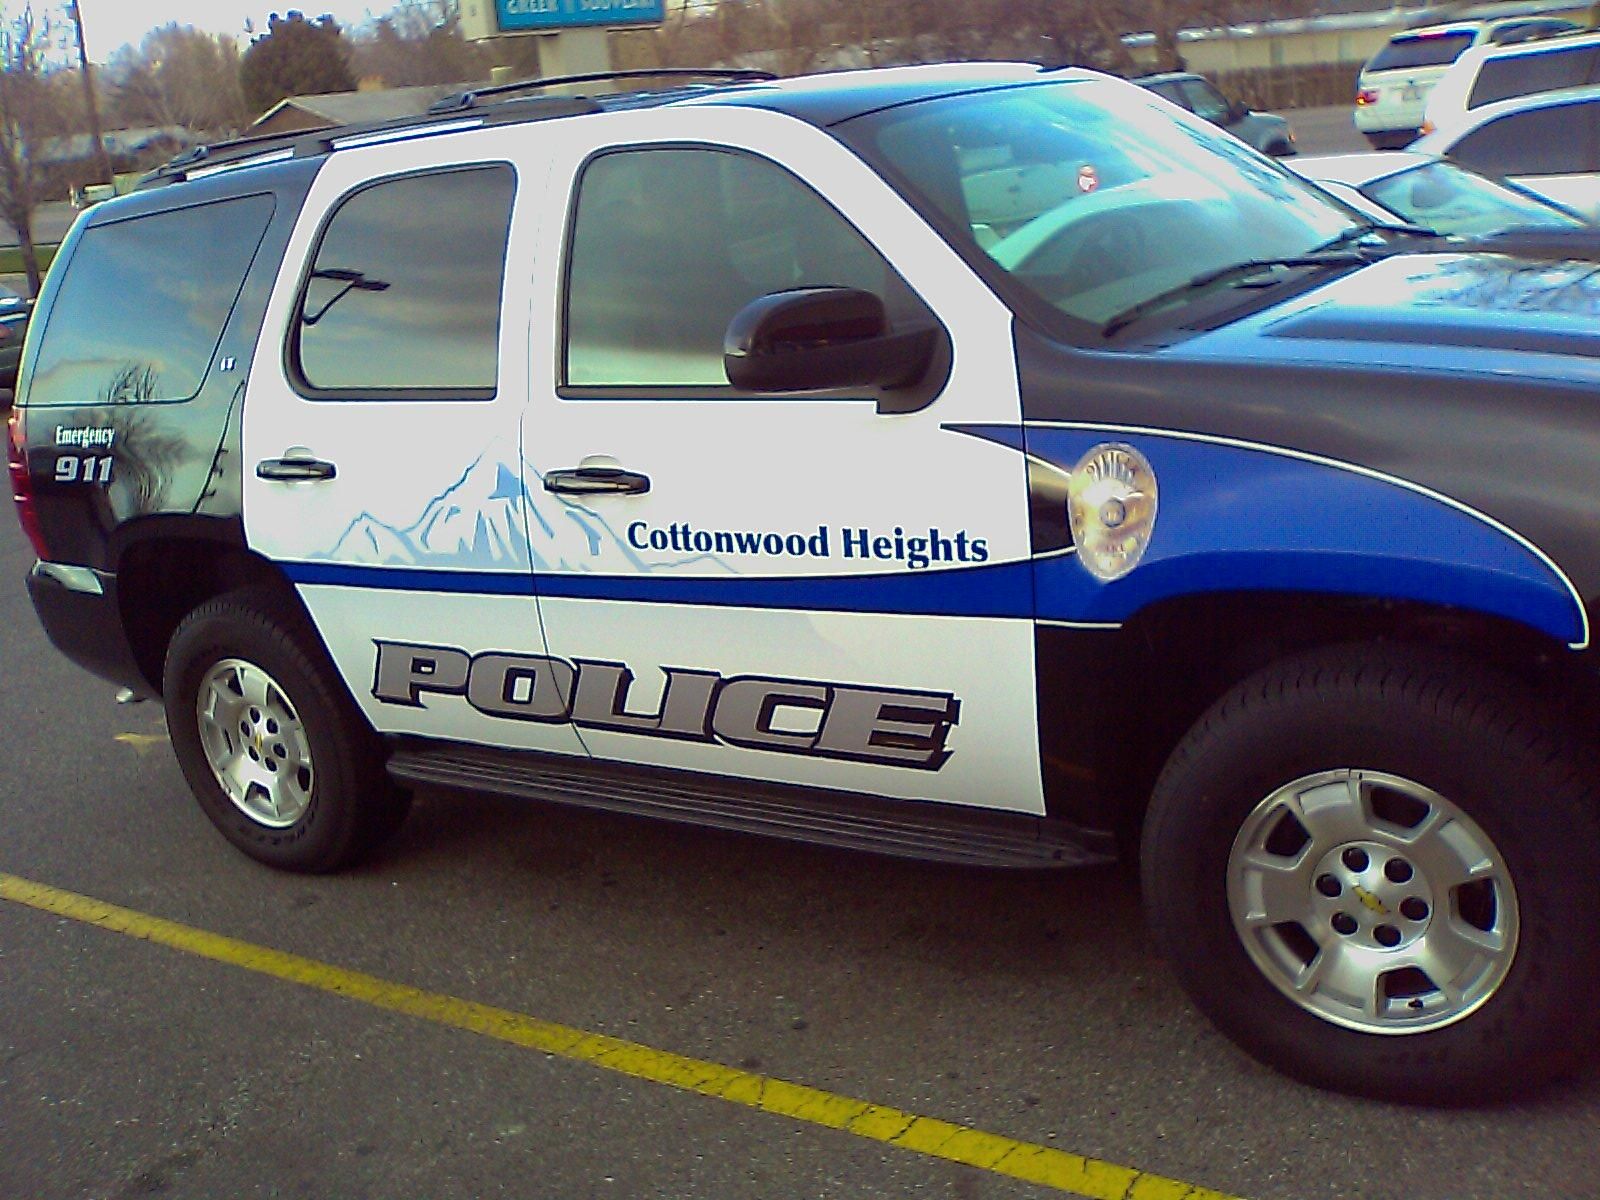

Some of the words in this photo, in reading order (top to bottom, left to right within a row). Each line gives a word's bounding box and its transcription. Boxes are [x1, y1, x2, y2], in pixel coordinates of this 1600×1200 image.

[55, 425, 115, 449] Emergency
[54, 455, 114, 483] 911
[626, 520, 830, 558] Cottonwood
[841, 526, 989, 570] Heights
[371, 637, 962, 773] POLICE
